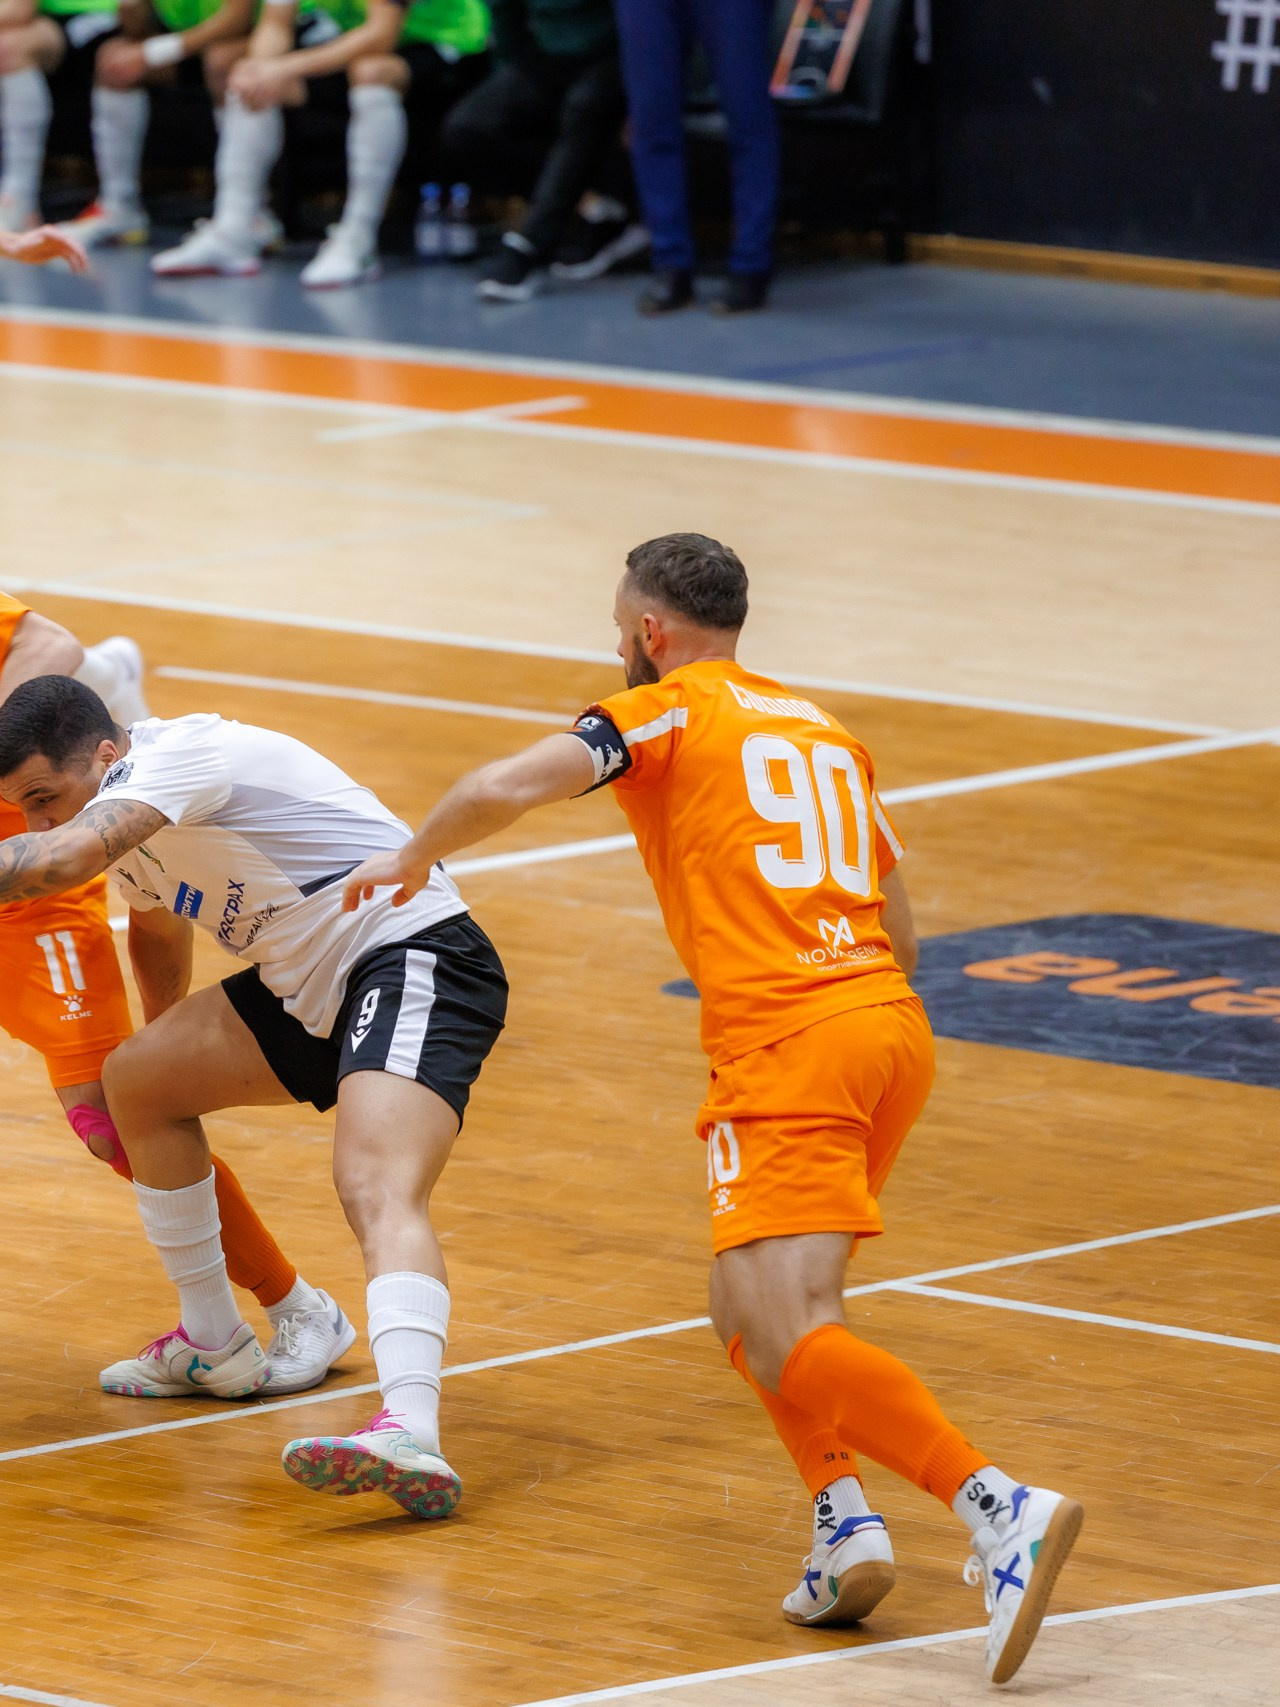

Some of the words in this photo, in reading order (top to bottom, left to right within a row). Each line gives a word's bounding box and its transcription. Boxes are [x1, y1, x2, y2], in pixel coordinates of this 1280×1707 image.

[740, 732, 871, 898] 90
[35, 930, 87, 994] 11
[961, 950, 1280, 1022] ena
[59, 1010, 93, 1021] KELME
[357, 987, 381, 1028] 9
[707, 1120, 741, 1191] 0
